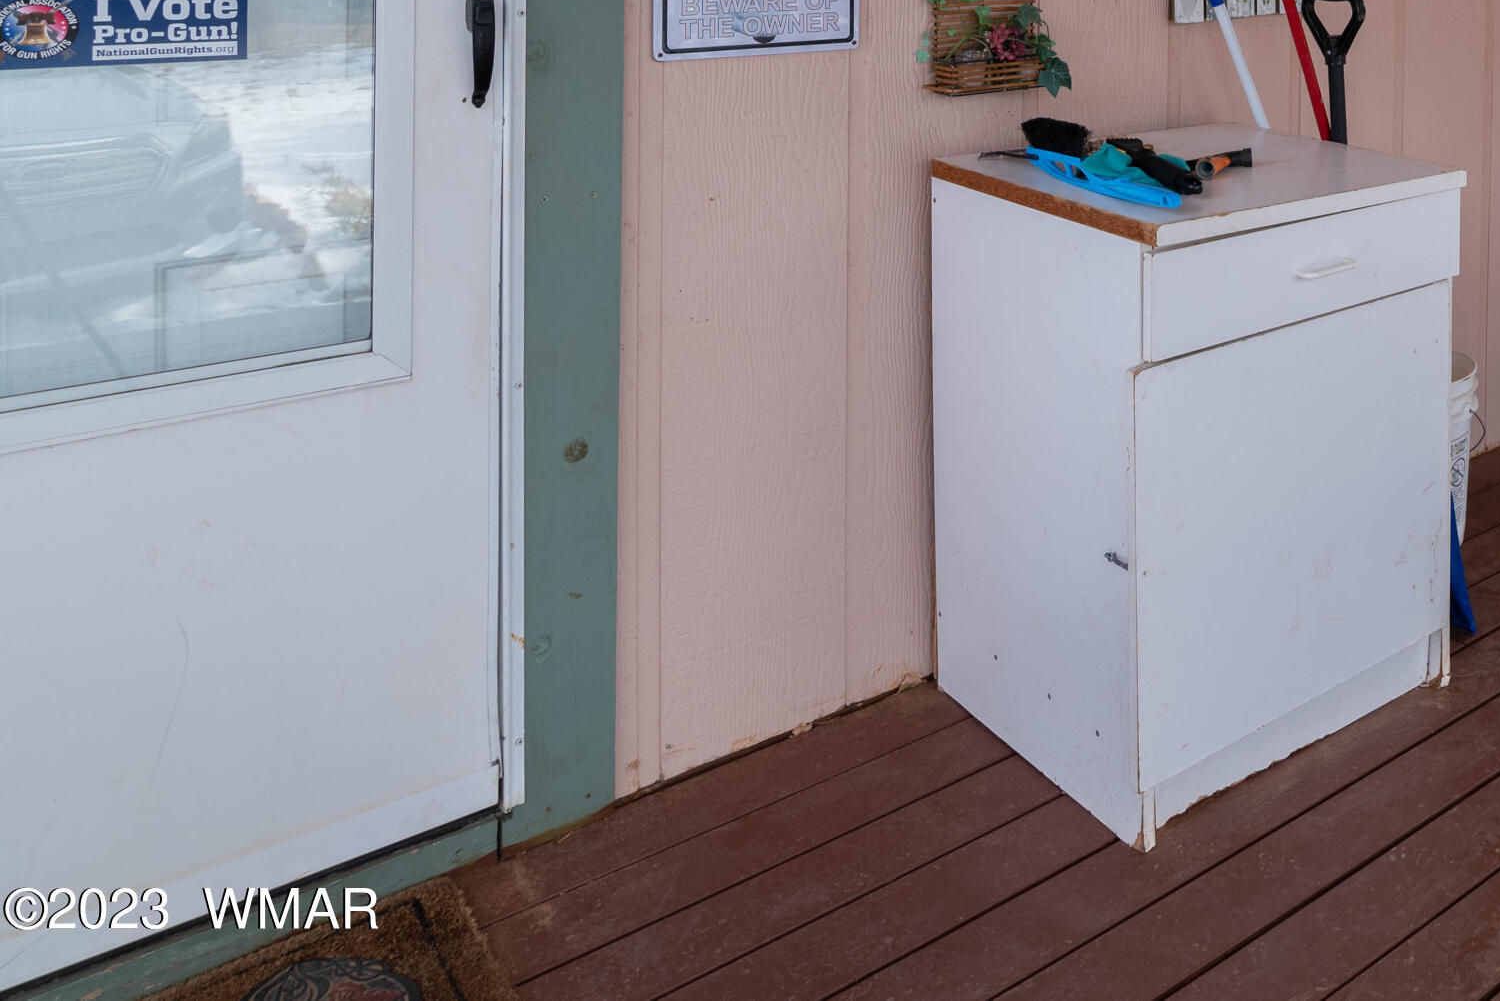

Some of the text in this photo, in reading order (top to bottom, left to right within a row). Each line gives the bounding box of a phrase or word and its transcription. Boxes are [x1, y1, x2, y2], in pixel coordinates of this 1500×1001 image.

[0, 0, 28, 26] ATIONAL
[93, 21, 238, 44] Pro-Gun!
[679, 12, 840, 40] THE OWNER
[17, 50, 38, 59] GUN
[41, 40, 72, 58] RIGHTS
[96, 44, 235, 57] NationalGunRights.org
